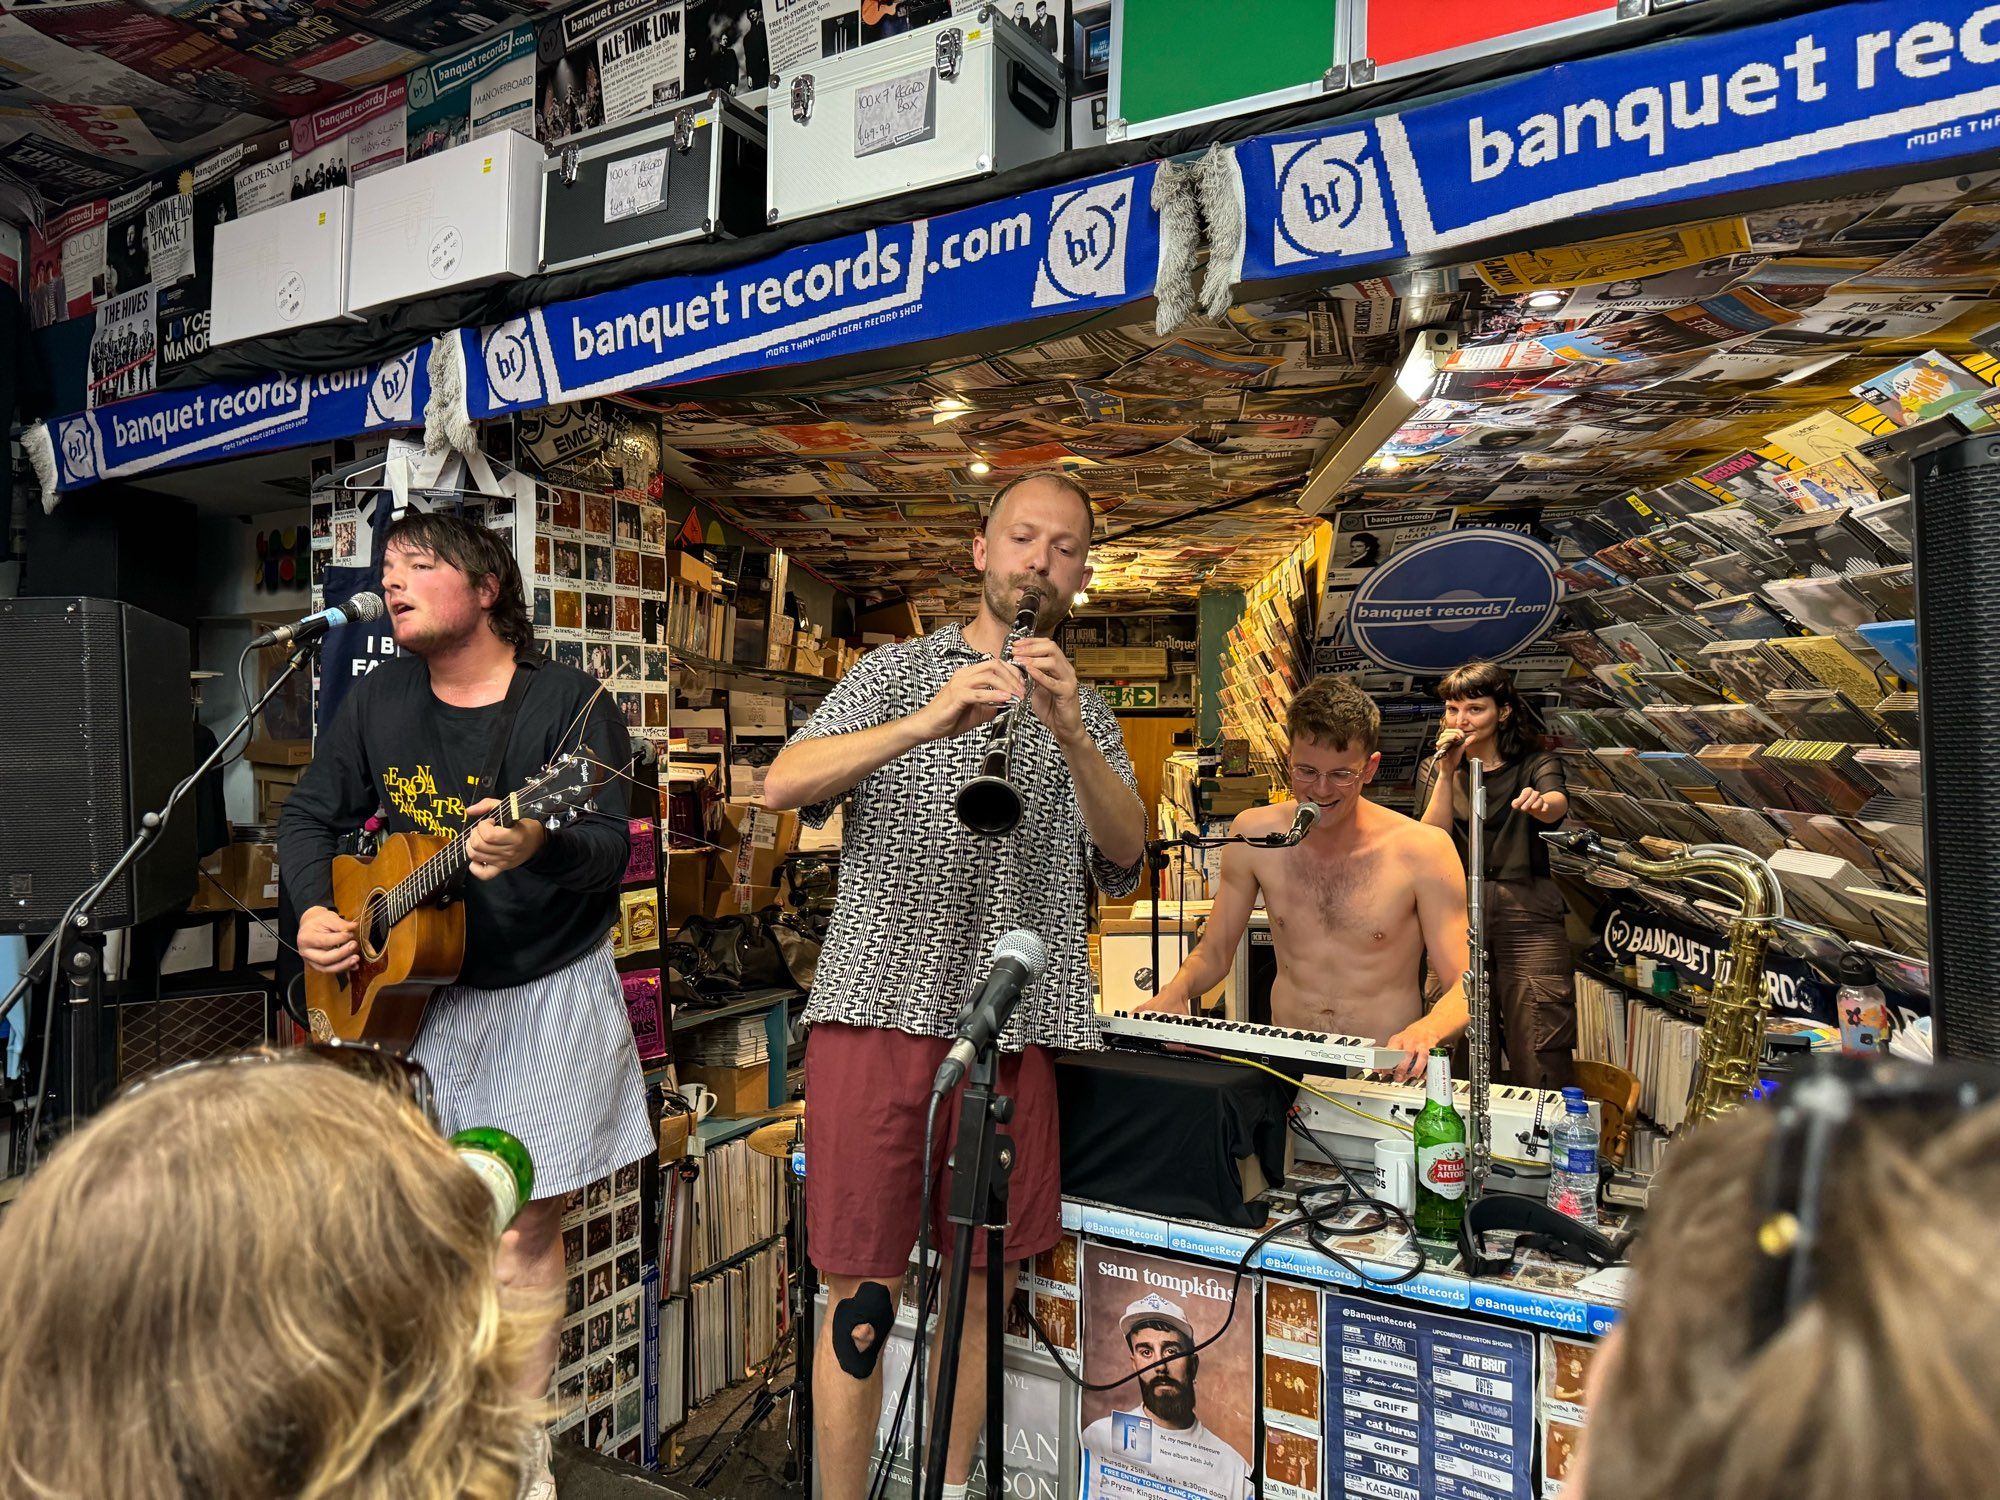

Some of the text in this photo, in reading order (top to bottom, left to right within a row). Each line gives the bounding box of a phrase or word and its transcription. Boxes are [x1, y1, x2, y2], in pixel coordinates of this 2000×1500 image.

[571, 5, 612, 33] banquet
[769, 18, 782, 29] FREE
[602, 10, 680, 68] ALL TIME LOW
[438, 32, 534, 81] banquet records .com
[319, 106, 353, 128] banquet
[354, 94, 383, 114] records
[858, 95, 873, 109] 100
[897, 96, 919, 113] BOX
[1469, 33, 1829, 184] banquet
[1907, 124, 1962, 150] MORE
[195, 160, 220, 179] banquet
[236, 159, 292, 191] JACK PEÑATE
[109, 194, 133, 214] banquet
[151, 217, 190, 252] JACKET
[572, 211, 1032, 362] banquet records .com
[104, 290, 149, 326] THE HIVES
[165, 310, 210, 342] JOYCE
[765, 304, 923, 359] MORE THAN YOUR LOCAL RECORD SHOP
[112, 365, 368, 448] banquet records .com
[1371, 512, 1431, 526] banquet records
[1358, 602, 1548, 621] banquet records .com
[1627, 925, 1711, 976] BANQUET
[1304, 1049, 1366, 1065] reface CS
[1085, 1220, 1164, 1243] @BanquetRecords
[1265, 1256, 1358, 1283] @BanquetRecords
[1098, 1261, 1237, 1303] sam tompkins
[1343, 1308, 1417, 1330] @BanquetRecords
[1474, 1296, 1583, 1324] @BanquetRecords
[1432, 1328, 1513, 1349] UPCOMING KINGSTON SHOWS
[1365, 1356, 1416, 1372] FRANK TURNER
[1462, 1353, 1480, 1369] ART
[1482, 1356, 1507, 1374] BRUT
[1374, 1399, 1408, 1414] GRIFF
[1366, 1420, 1417, 1439] cat burns
[1470, 1419, 1501, 1434] HAMISH
[1473, 1427, 1497, 1440] HAWK
[1160, 1449, 1172, 1457] New
[1172, 1451, 1190, 1460] album
[1177, 1438, 1192, 1447] name
[1198, 1444, 1221, 1456] insecure
[1374, 1442, 1408, 1457] GRIFF
[1460, 1442, 1498, 1459] LOVELESS
[1101, 1456, 1129, 1472] Thursday
[1130, 1465, 1145, 1475] 25th
[1147, 1470, 1160, 1481] July
[1182, 1479, 1208, 1494] 8:30pm
[1209, 1487, 1228, 1500] doors
[1104, 1467, 1120, 1478] FREE
[1120, 1471, 1142, 1484] ENTRY
[1142, 1478, 1151, 1487] TO
[1151, 1480, 1167, 1492] NEW
[1374, 1460, 1409, 1481] TRAVIS
[1470, 1464, 1501, 1483] james
[1110, 1481, 1134, 1495] Pryzm,
[1366, 1481, 1418, 1500] KASABIAN
